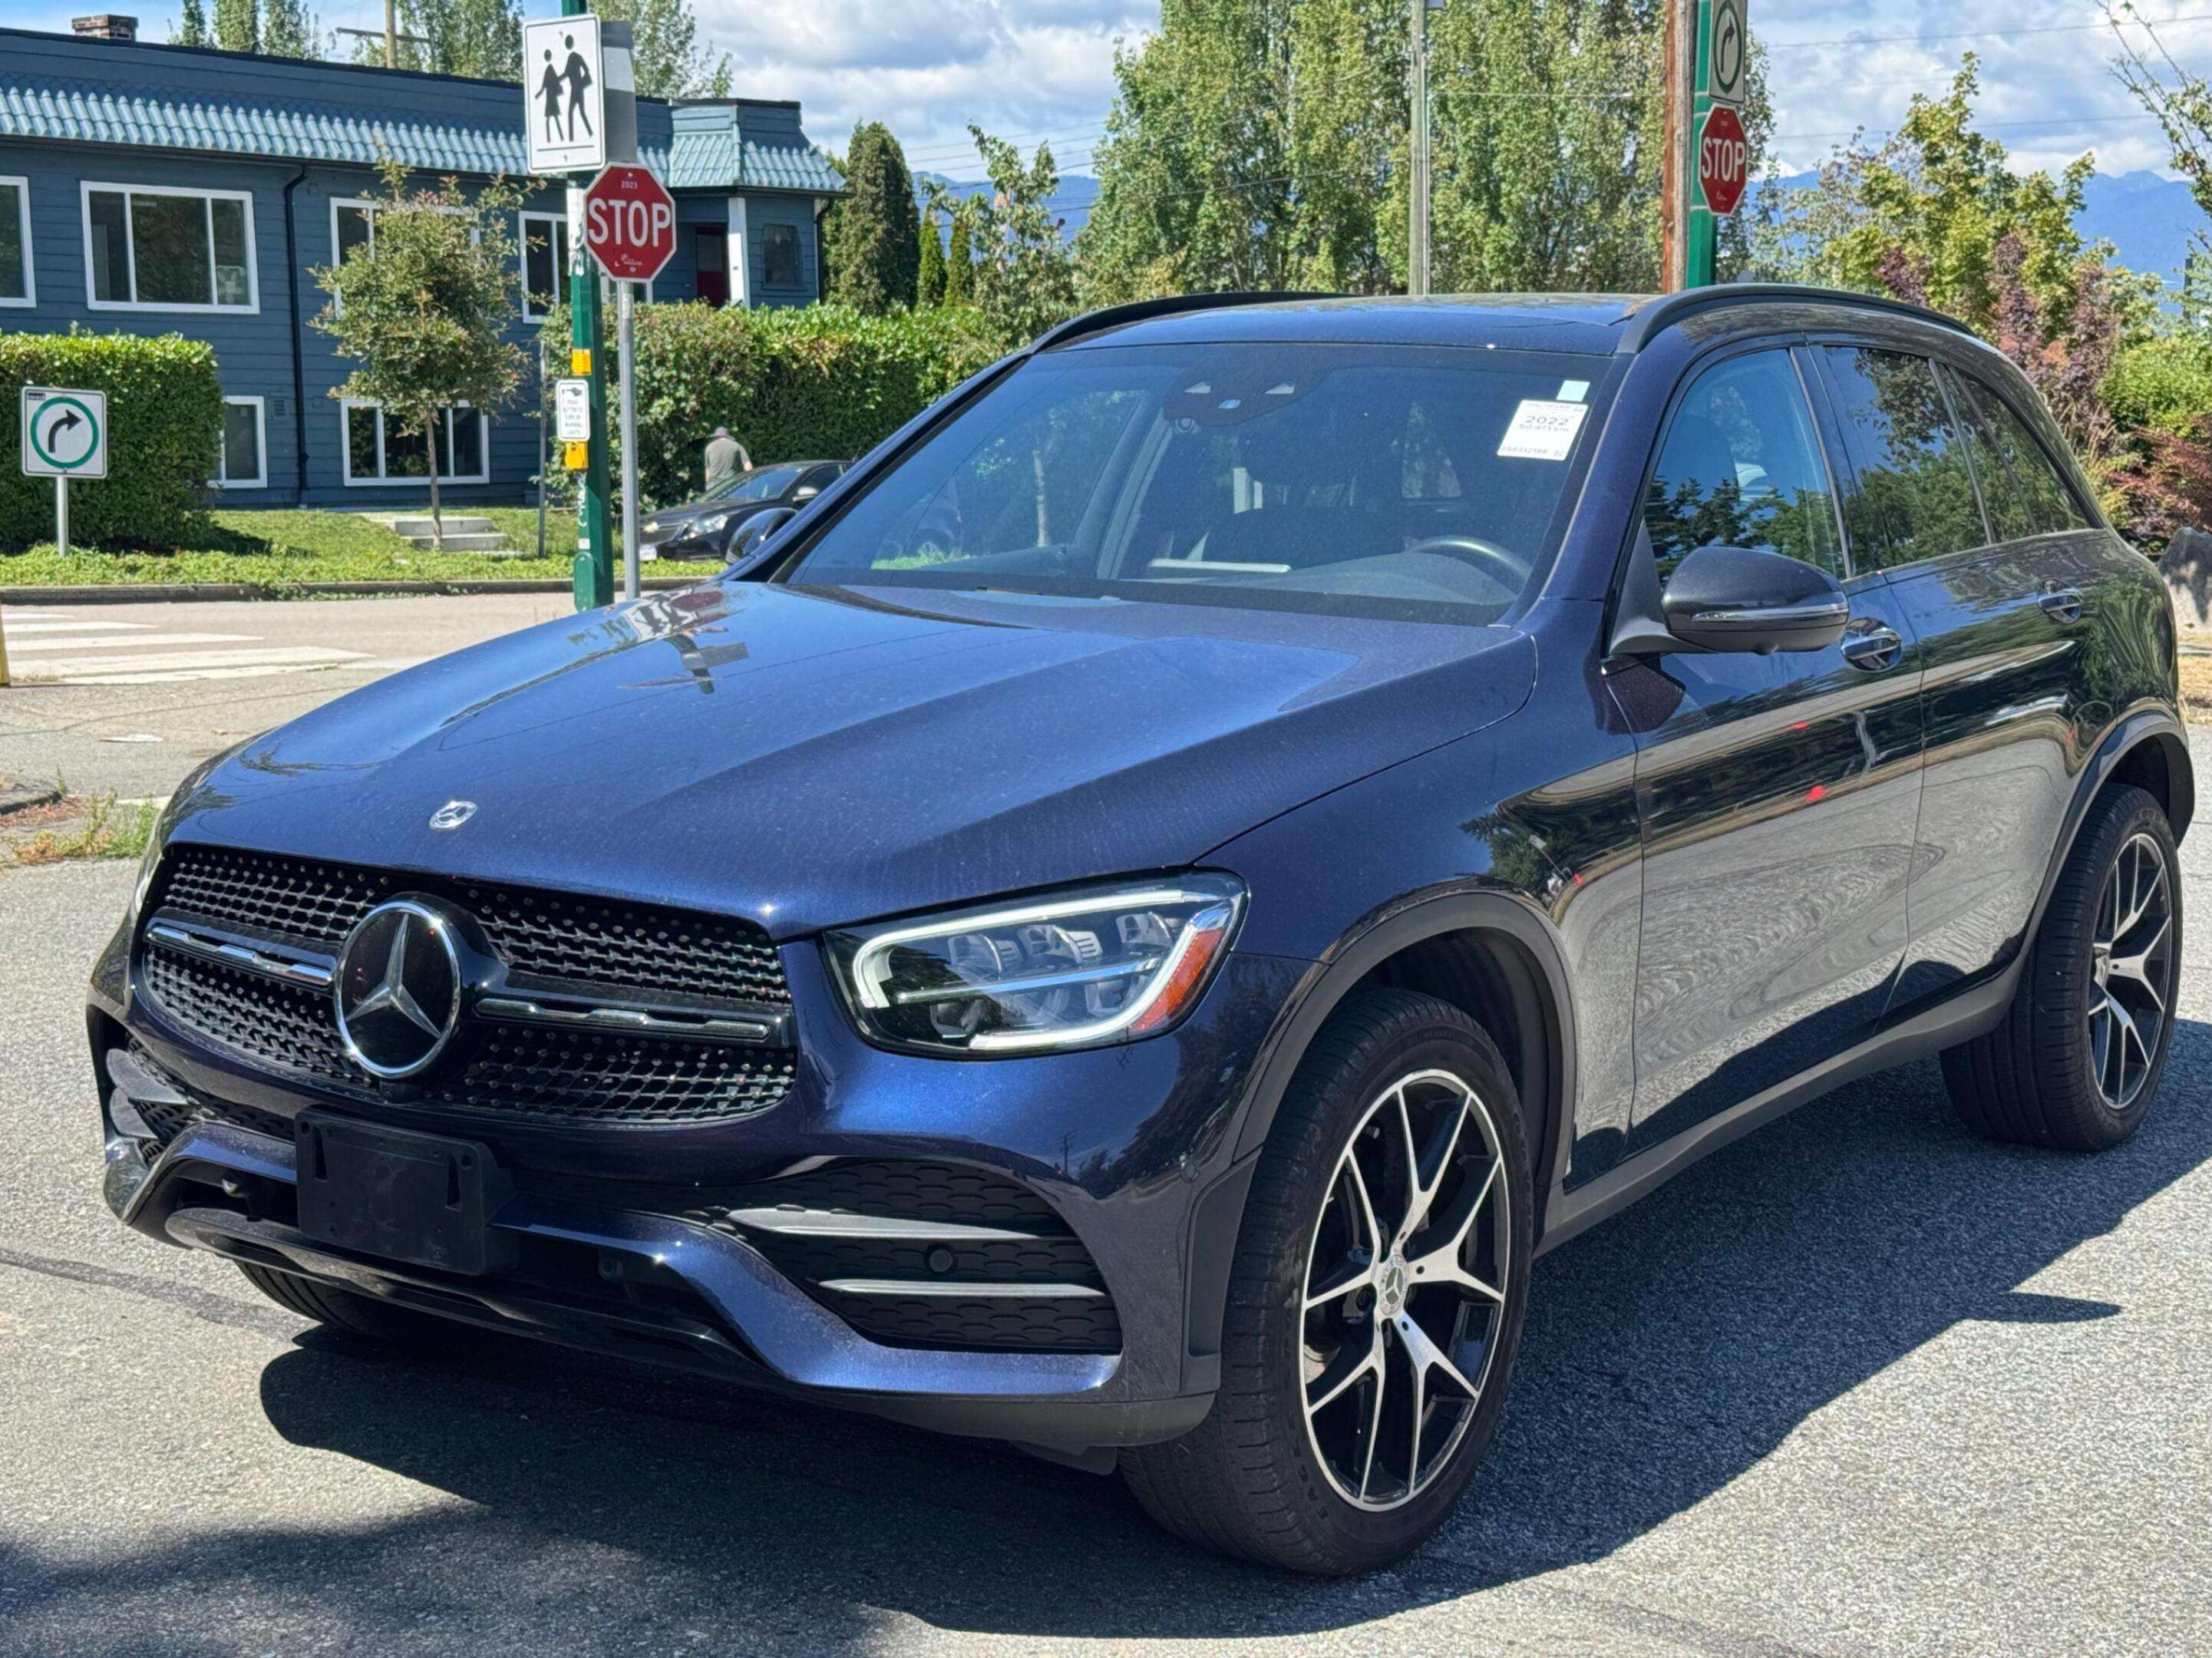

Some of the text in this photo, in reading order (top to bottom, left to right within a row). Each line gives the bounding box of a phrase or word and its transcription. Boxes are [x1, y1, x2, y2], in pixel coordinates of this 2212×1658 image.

[1702, 137, 1745, 183] STOP
[588, 197, 672, 247] STOP
[1524, 415, 1569, 427] 2022
